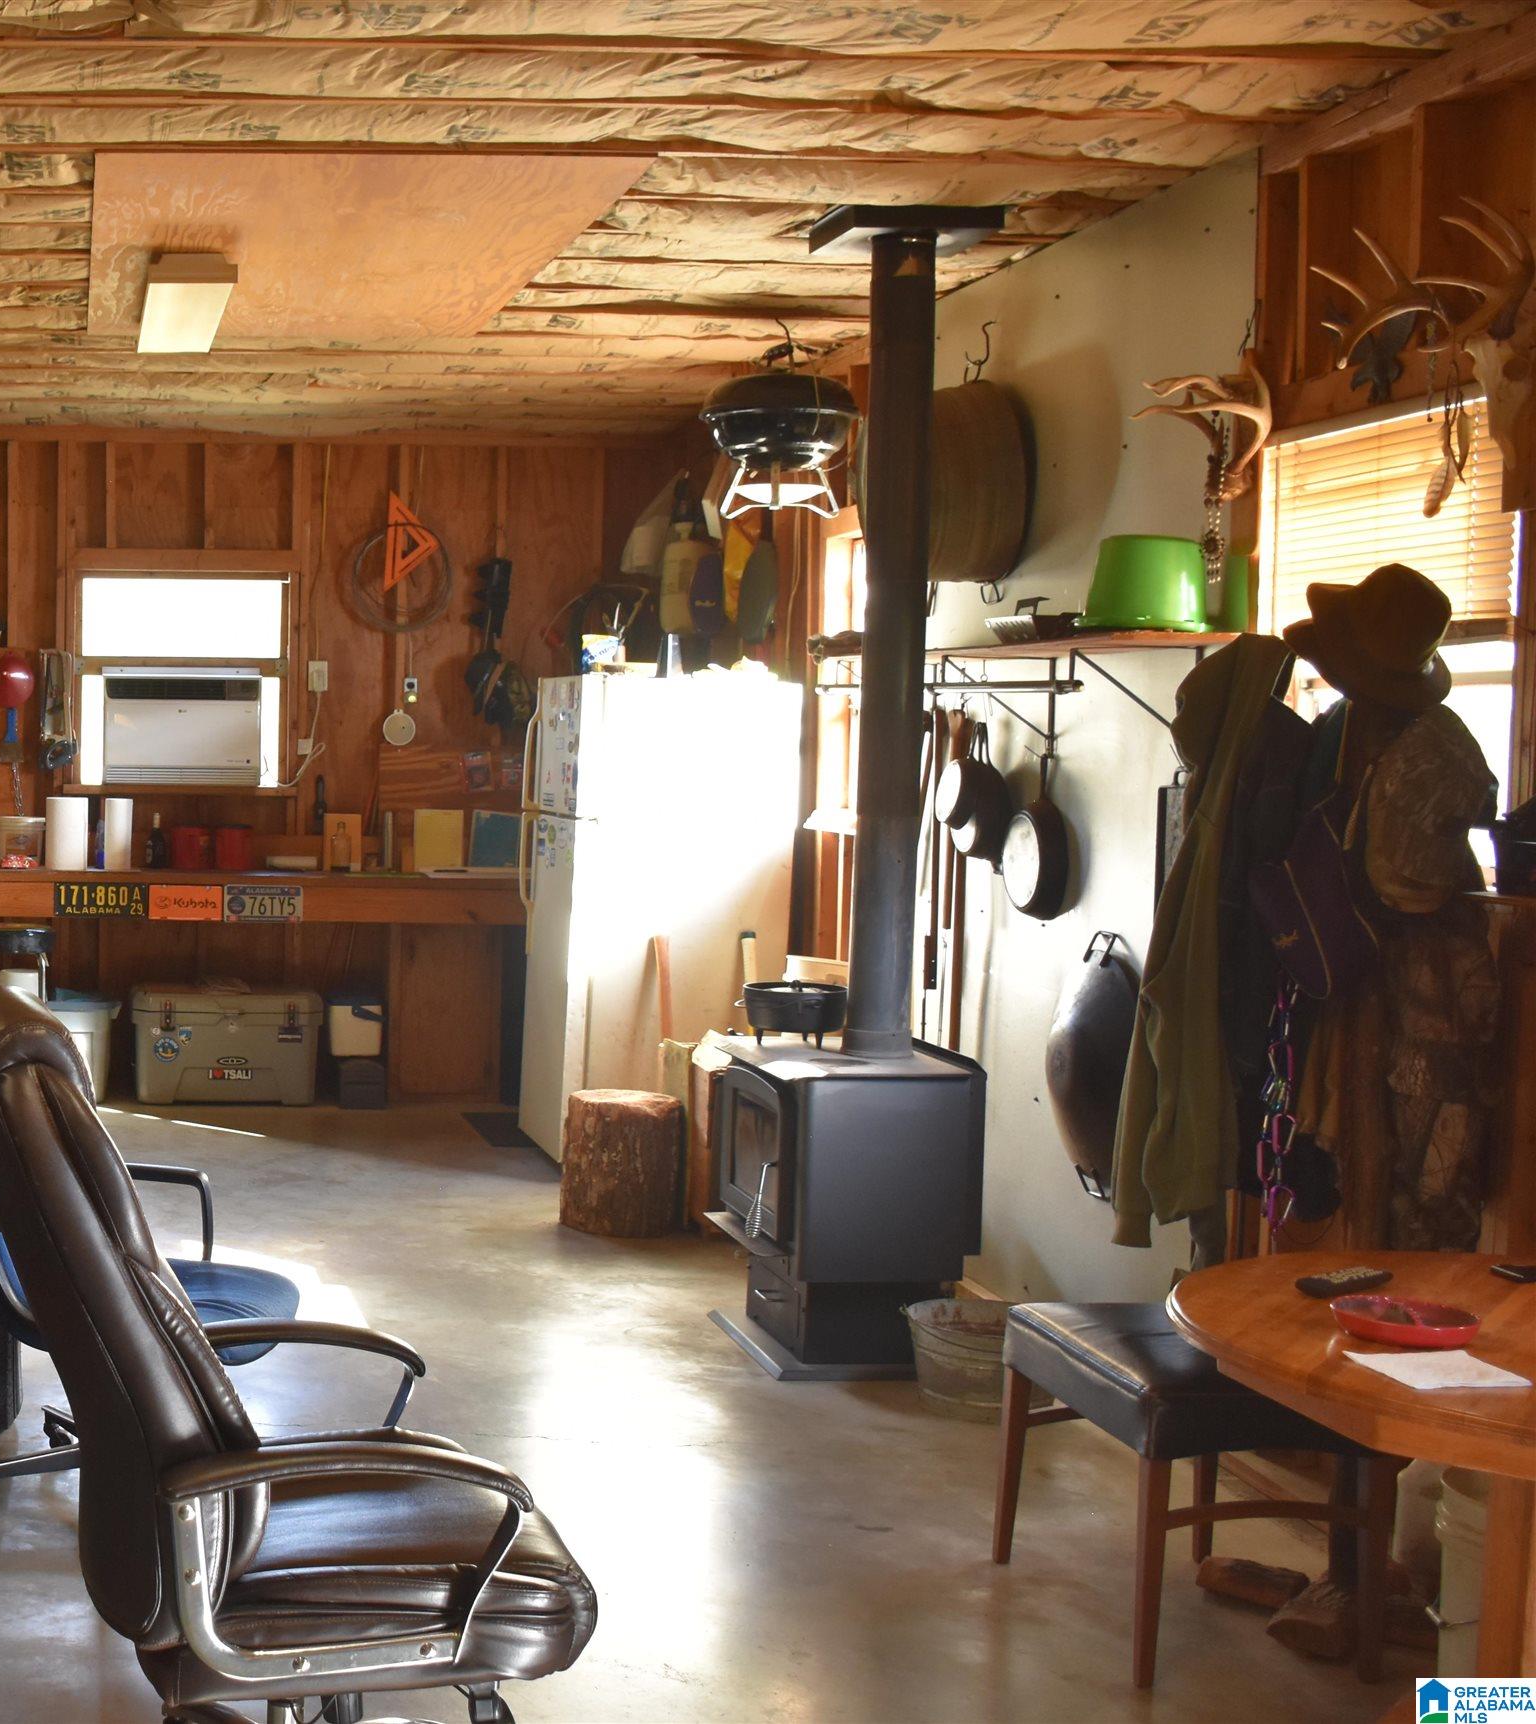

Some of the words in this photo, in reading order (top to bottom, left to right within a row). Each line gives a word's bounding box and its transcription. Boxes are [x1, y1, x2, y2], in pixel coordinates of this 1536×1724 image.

[173, 897, 218, 910] Kubota
[249, 896, 296, 916] 76TY5
[65, 906, 121, 914] ALABAMA
[223, 1069, 252, 1080] TSALI
